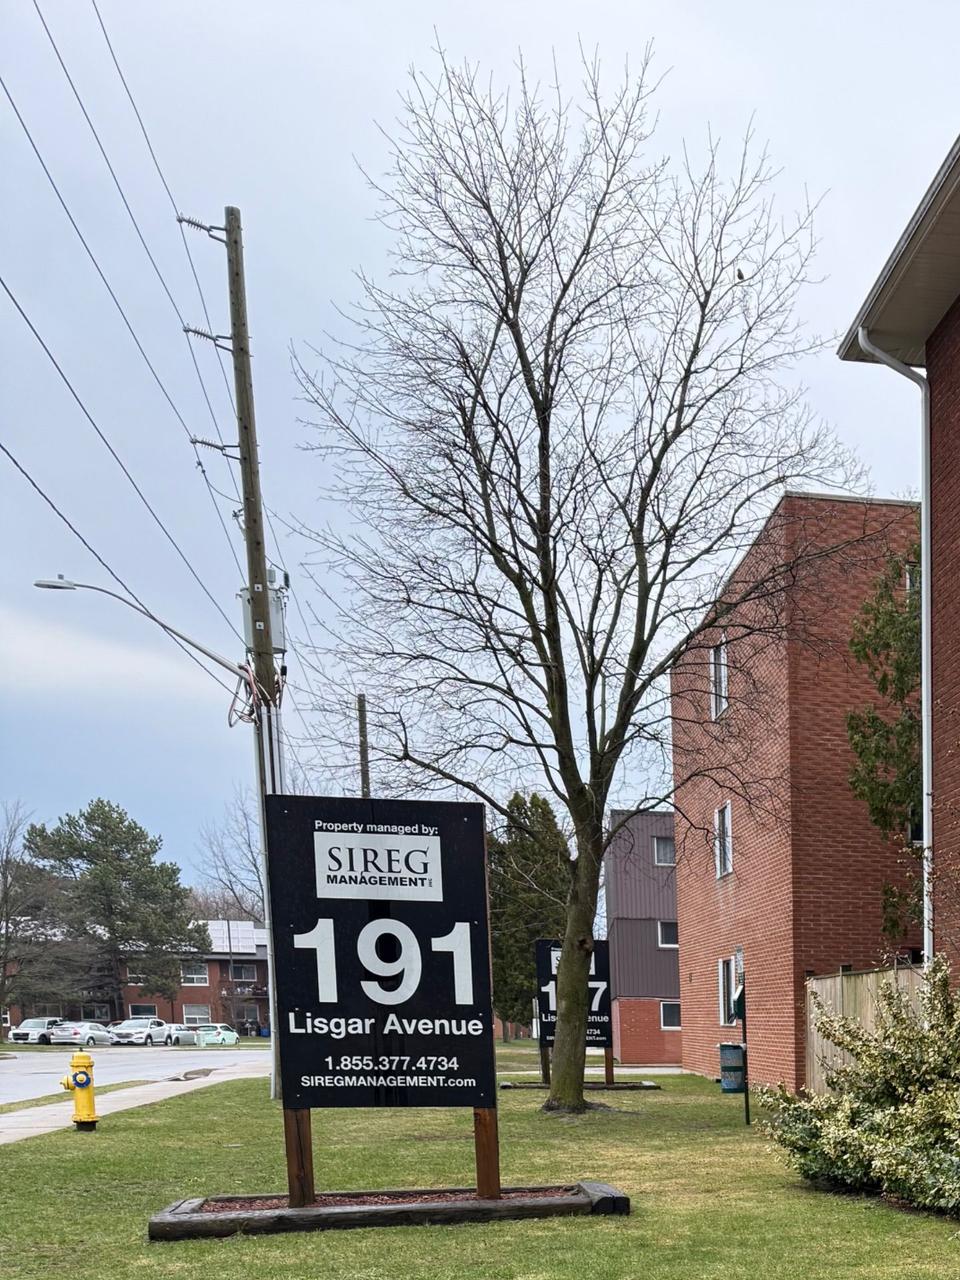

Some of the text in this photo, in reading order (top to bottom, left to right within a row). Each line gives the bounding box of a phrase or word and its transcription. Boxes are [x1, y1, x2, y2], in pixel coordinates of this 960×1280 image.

[314, 820, 439, 835] Property managed by:
[327, 846, 430, 875] SIREG
[326, 874, 427, 887] MANAGEMENT
[293, 918, 474, 1005] 191
[541, 980, 608, 1011] 17
[288, 1012, 484, 1039] Lisgar Avenue
[324, 1056, 459, 1071] 1.855.377.4734
[300, 1075, 476, 1087] SIREGMANAGEMENT.com
